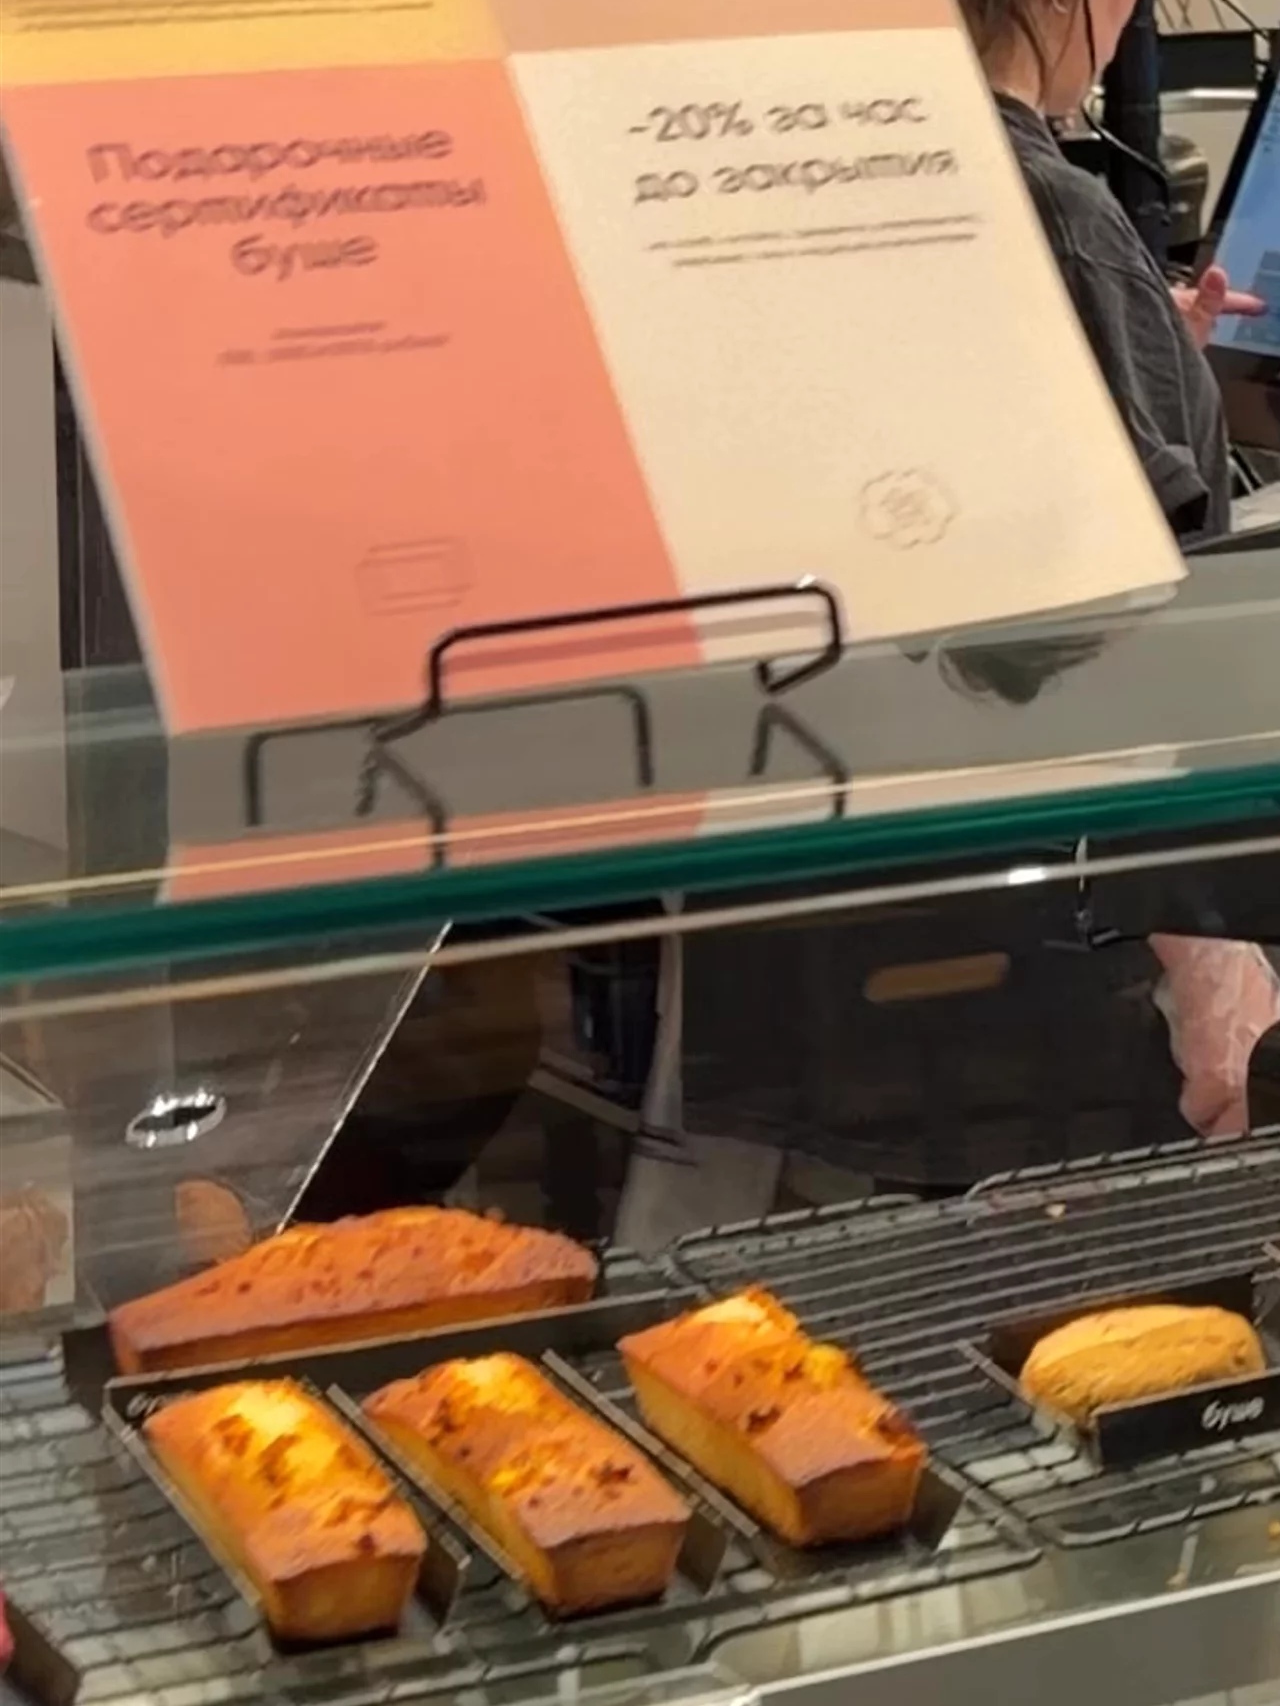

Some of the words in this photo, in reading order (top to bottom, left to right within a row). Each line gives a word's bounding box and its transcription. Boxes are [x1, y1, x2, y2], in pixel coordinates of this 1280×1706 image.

[628, 98, 754, 142] -20%
[763, 103, 828, 134] за
[837, 97, 929, 126] час
[86, 130, 452, 183] Подарочные
[633, 170, 698, 205] до
[711, 149, 958, 194] закрытия
[86, 178, 486, 238] сертификаты
[230, 234, 379, 282] буше
